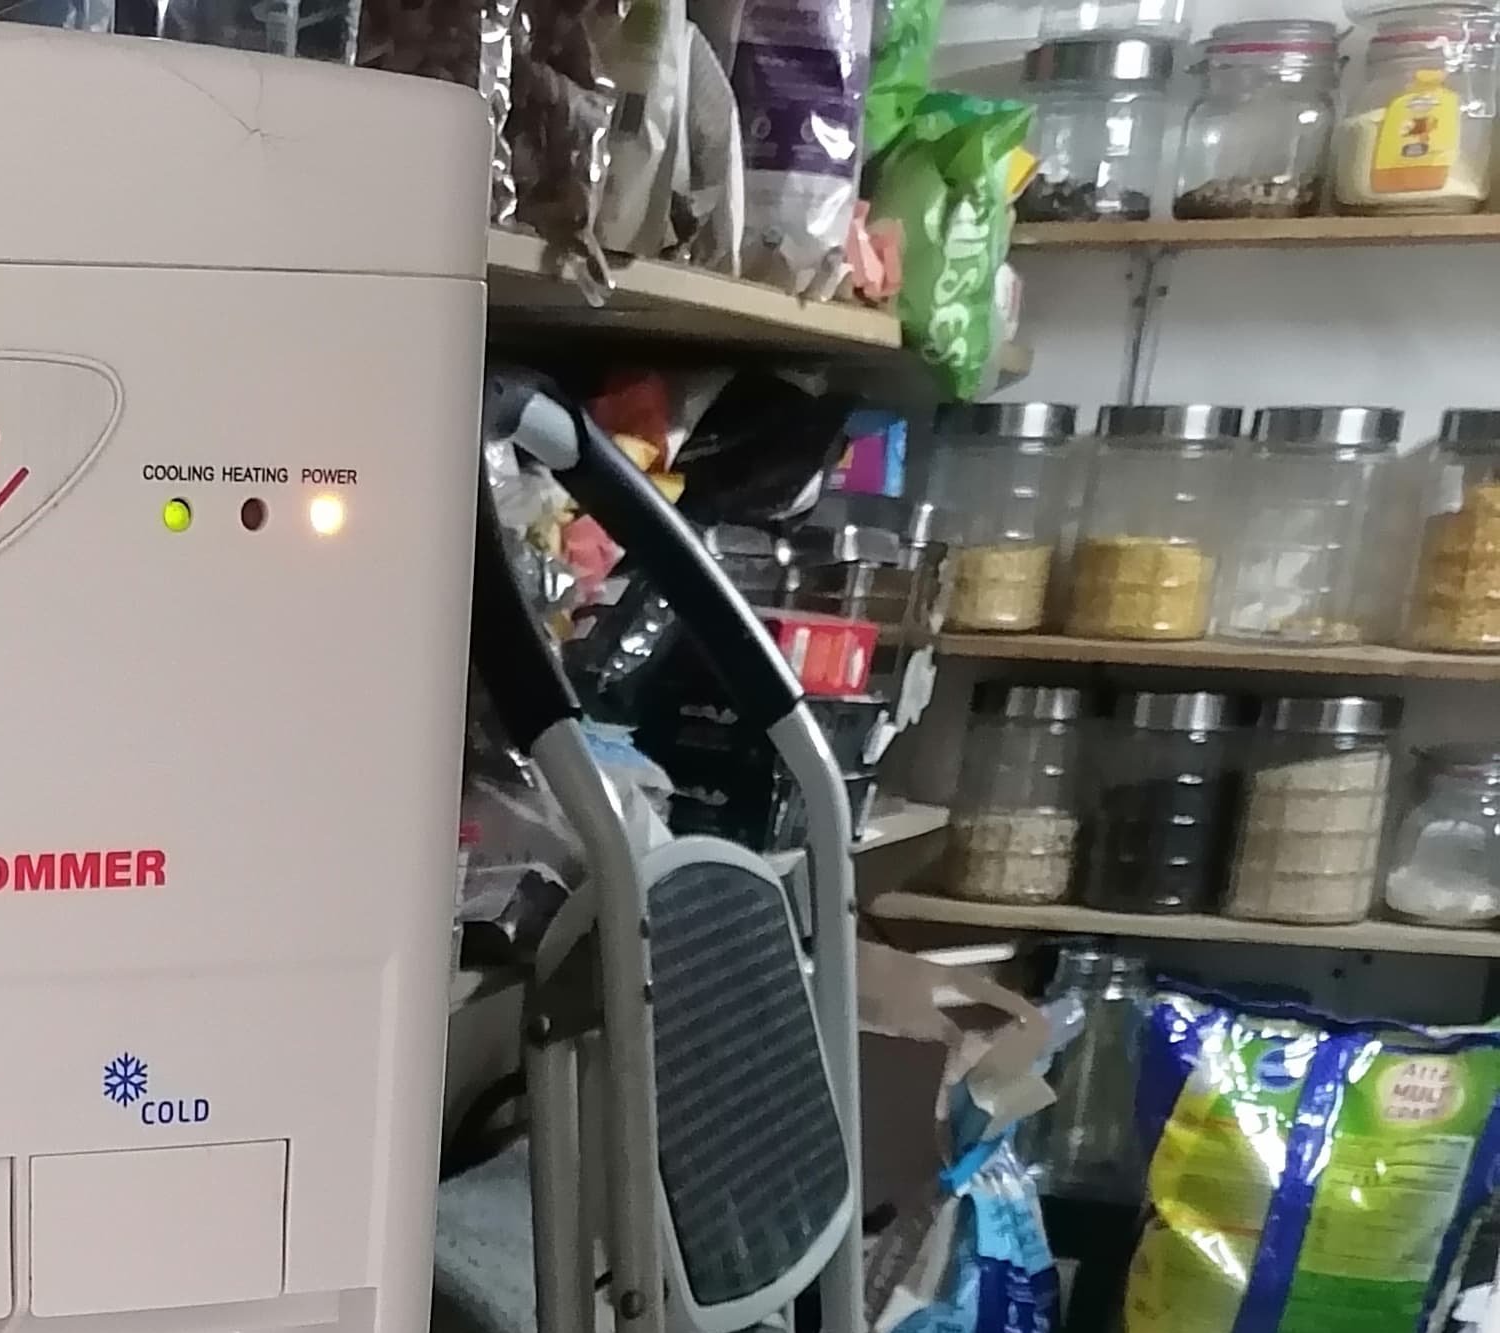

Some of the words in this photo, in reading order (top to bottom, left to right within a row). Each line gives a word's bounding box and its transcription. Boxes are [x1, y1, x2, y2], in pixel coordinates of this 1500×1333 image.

[142, 464, 215, 482] COOLING
[221, 465, 289, 484] HEATING
[301, 468, 358, 485] POWER
[141, 1098, 210, 1126] COLD
